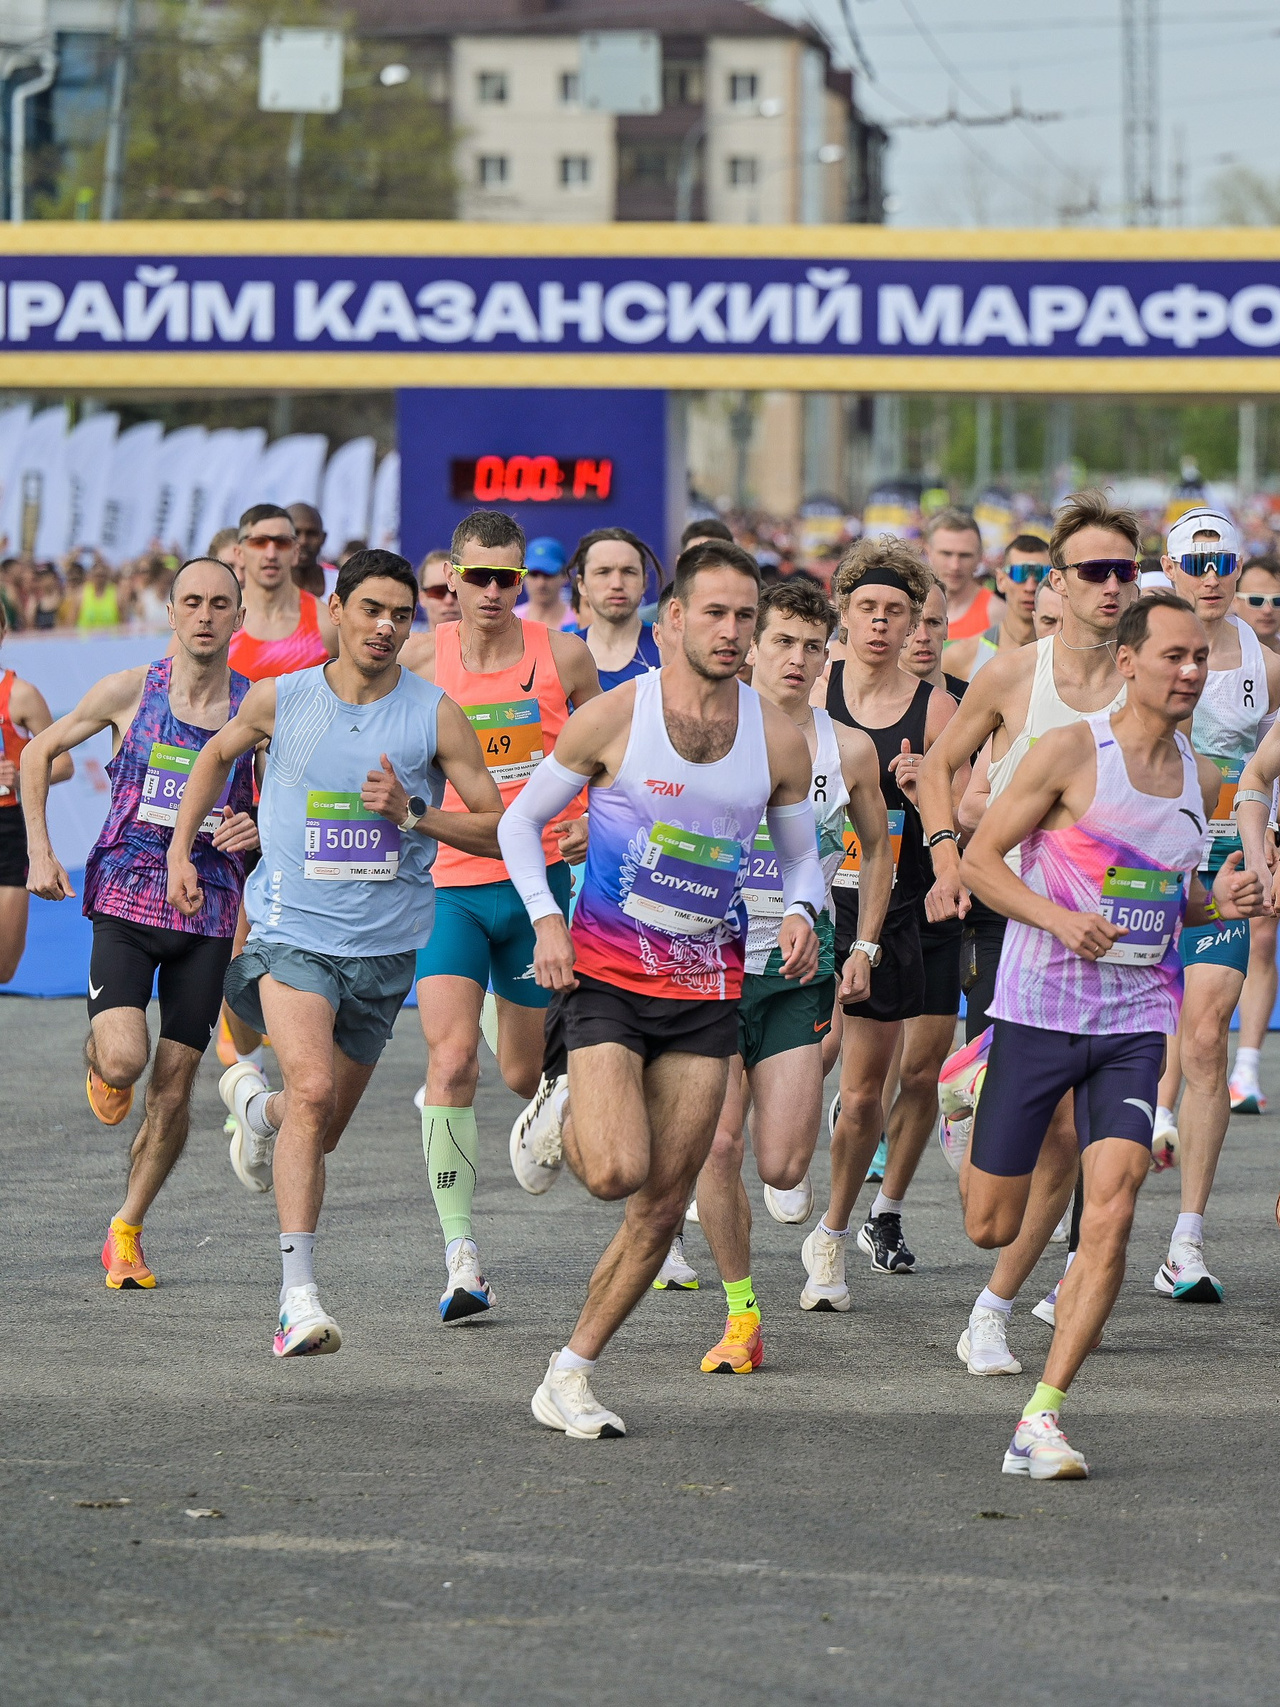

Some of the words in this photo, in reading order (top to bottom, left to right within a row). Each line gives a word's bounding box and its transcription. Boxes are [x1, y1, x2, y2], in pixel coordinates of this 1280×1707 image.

[0, 264, 275, 342] РАЙМ
[294, 266, 862, 345] КАЗАНСКИЙ
[486, 735, 511, 755] 49
[147, 777, 155, 795] ELITE
[643, 779, 686, 797] RAY
[326, 828, 382, 849] 5009
[646, 846, 658, 866] ELITE
[650, 871, 719, 899] СЛУХИН
[1116, 907, 1165, 932] 5008
